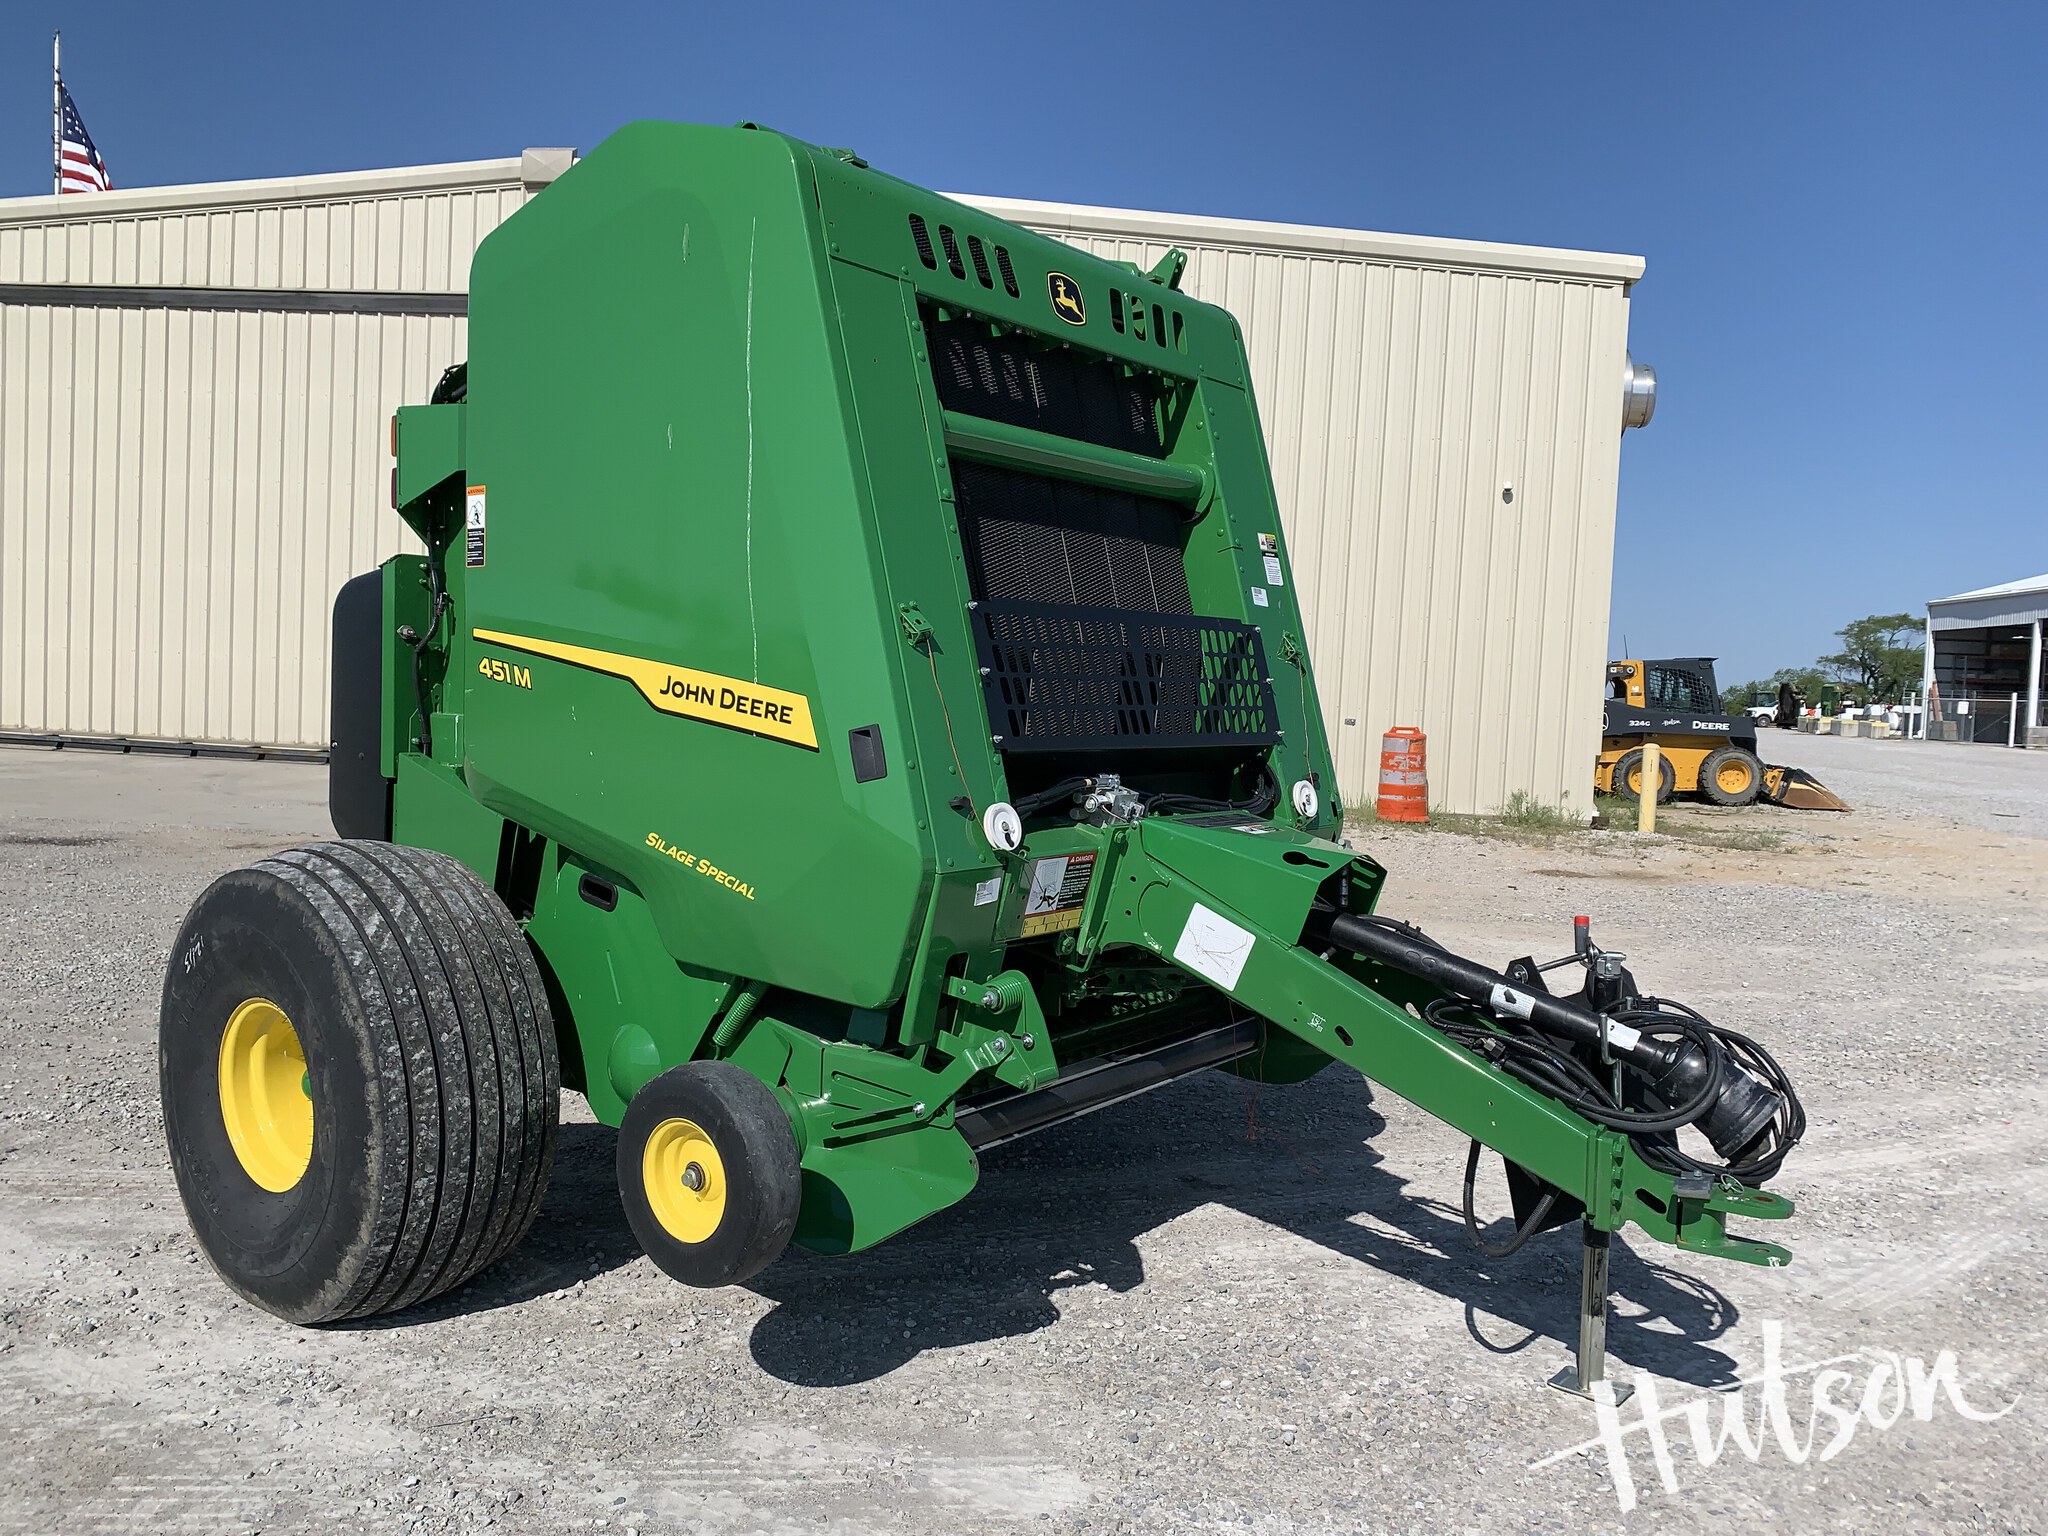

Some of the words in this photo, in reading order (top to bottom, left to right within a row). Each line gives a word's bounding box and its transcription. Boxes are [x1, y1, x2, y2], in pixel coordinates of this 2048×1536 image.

[659, 675, 715, 706] JOHN
[719, 687, 794, 725] DEERE
[1692, 720, 1730, 731] DEERE
[645, 832, 696, 867] SILAGE
[696, 858, 755, 900] SPECIAL
